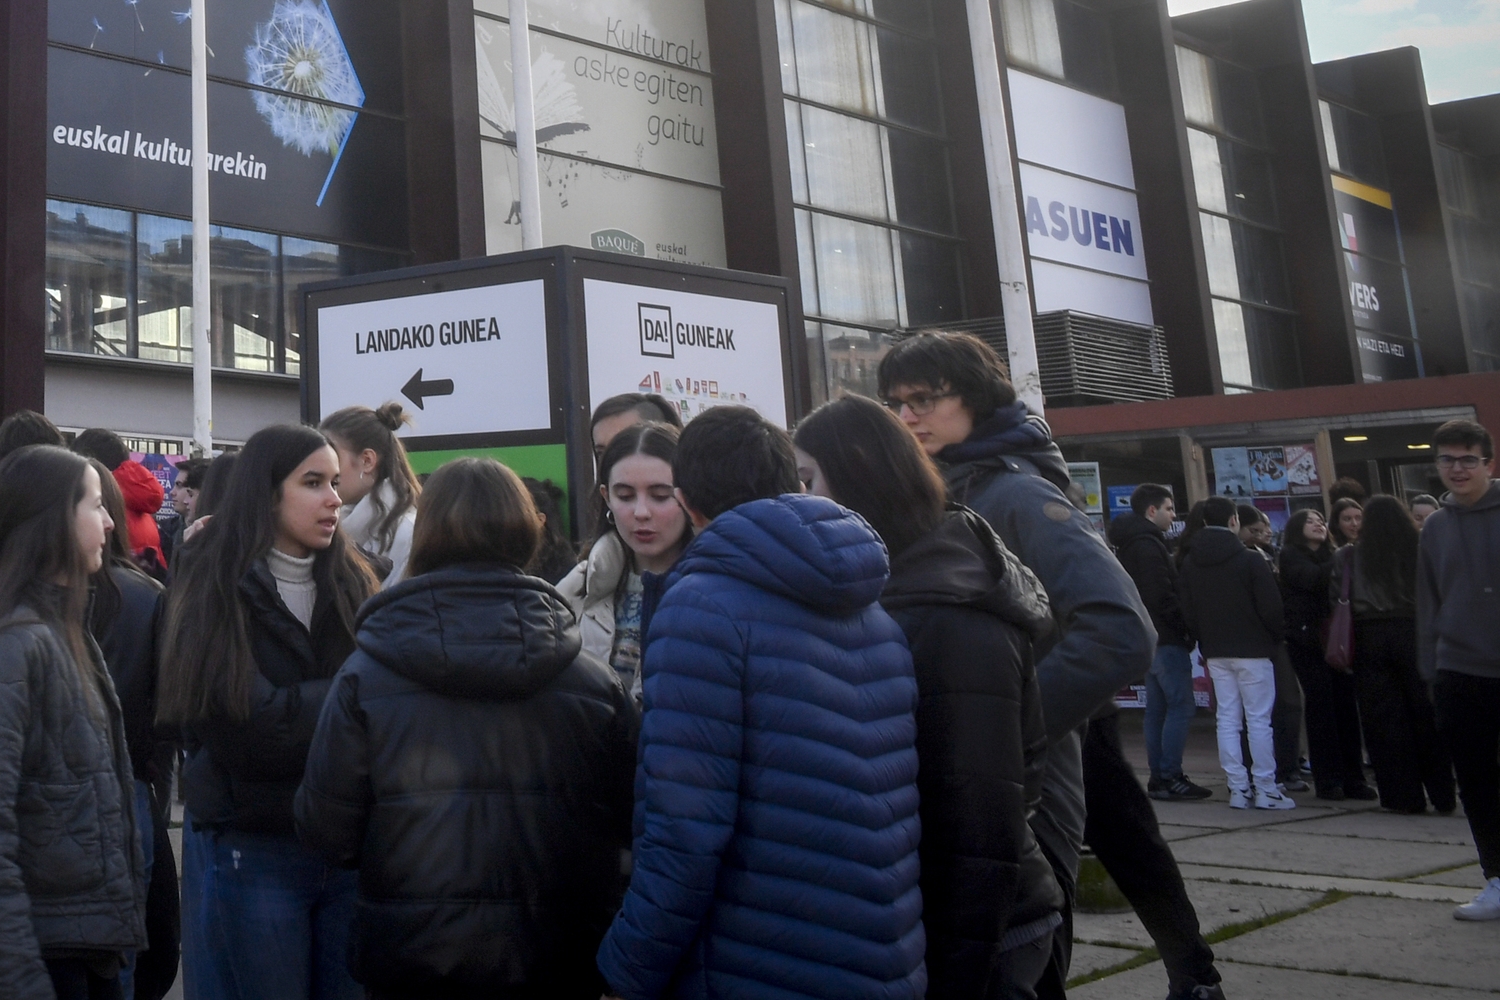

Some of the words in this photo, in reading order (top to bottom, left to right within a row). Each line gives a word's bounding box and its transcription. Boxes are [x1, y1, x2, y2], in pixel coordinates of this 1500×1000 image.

[606, 16, 702, 71] Kulturak
[574, 53, 630, 88] aske
[634, 69, 703, 107] egiten
[52, 125, 130, 155] euskal
[647, 113, 705, 147] gaitu
[596, 235, 639, 256] BAQUÉ
[655, 242, 687, 256] euskal
[356, 324, 435, 355] LANDAKO
[439, 316, 501, 346] GUNEA
[643, 318, 669, 343] DA!
[675, 322, 736, 351] GUNEAK
